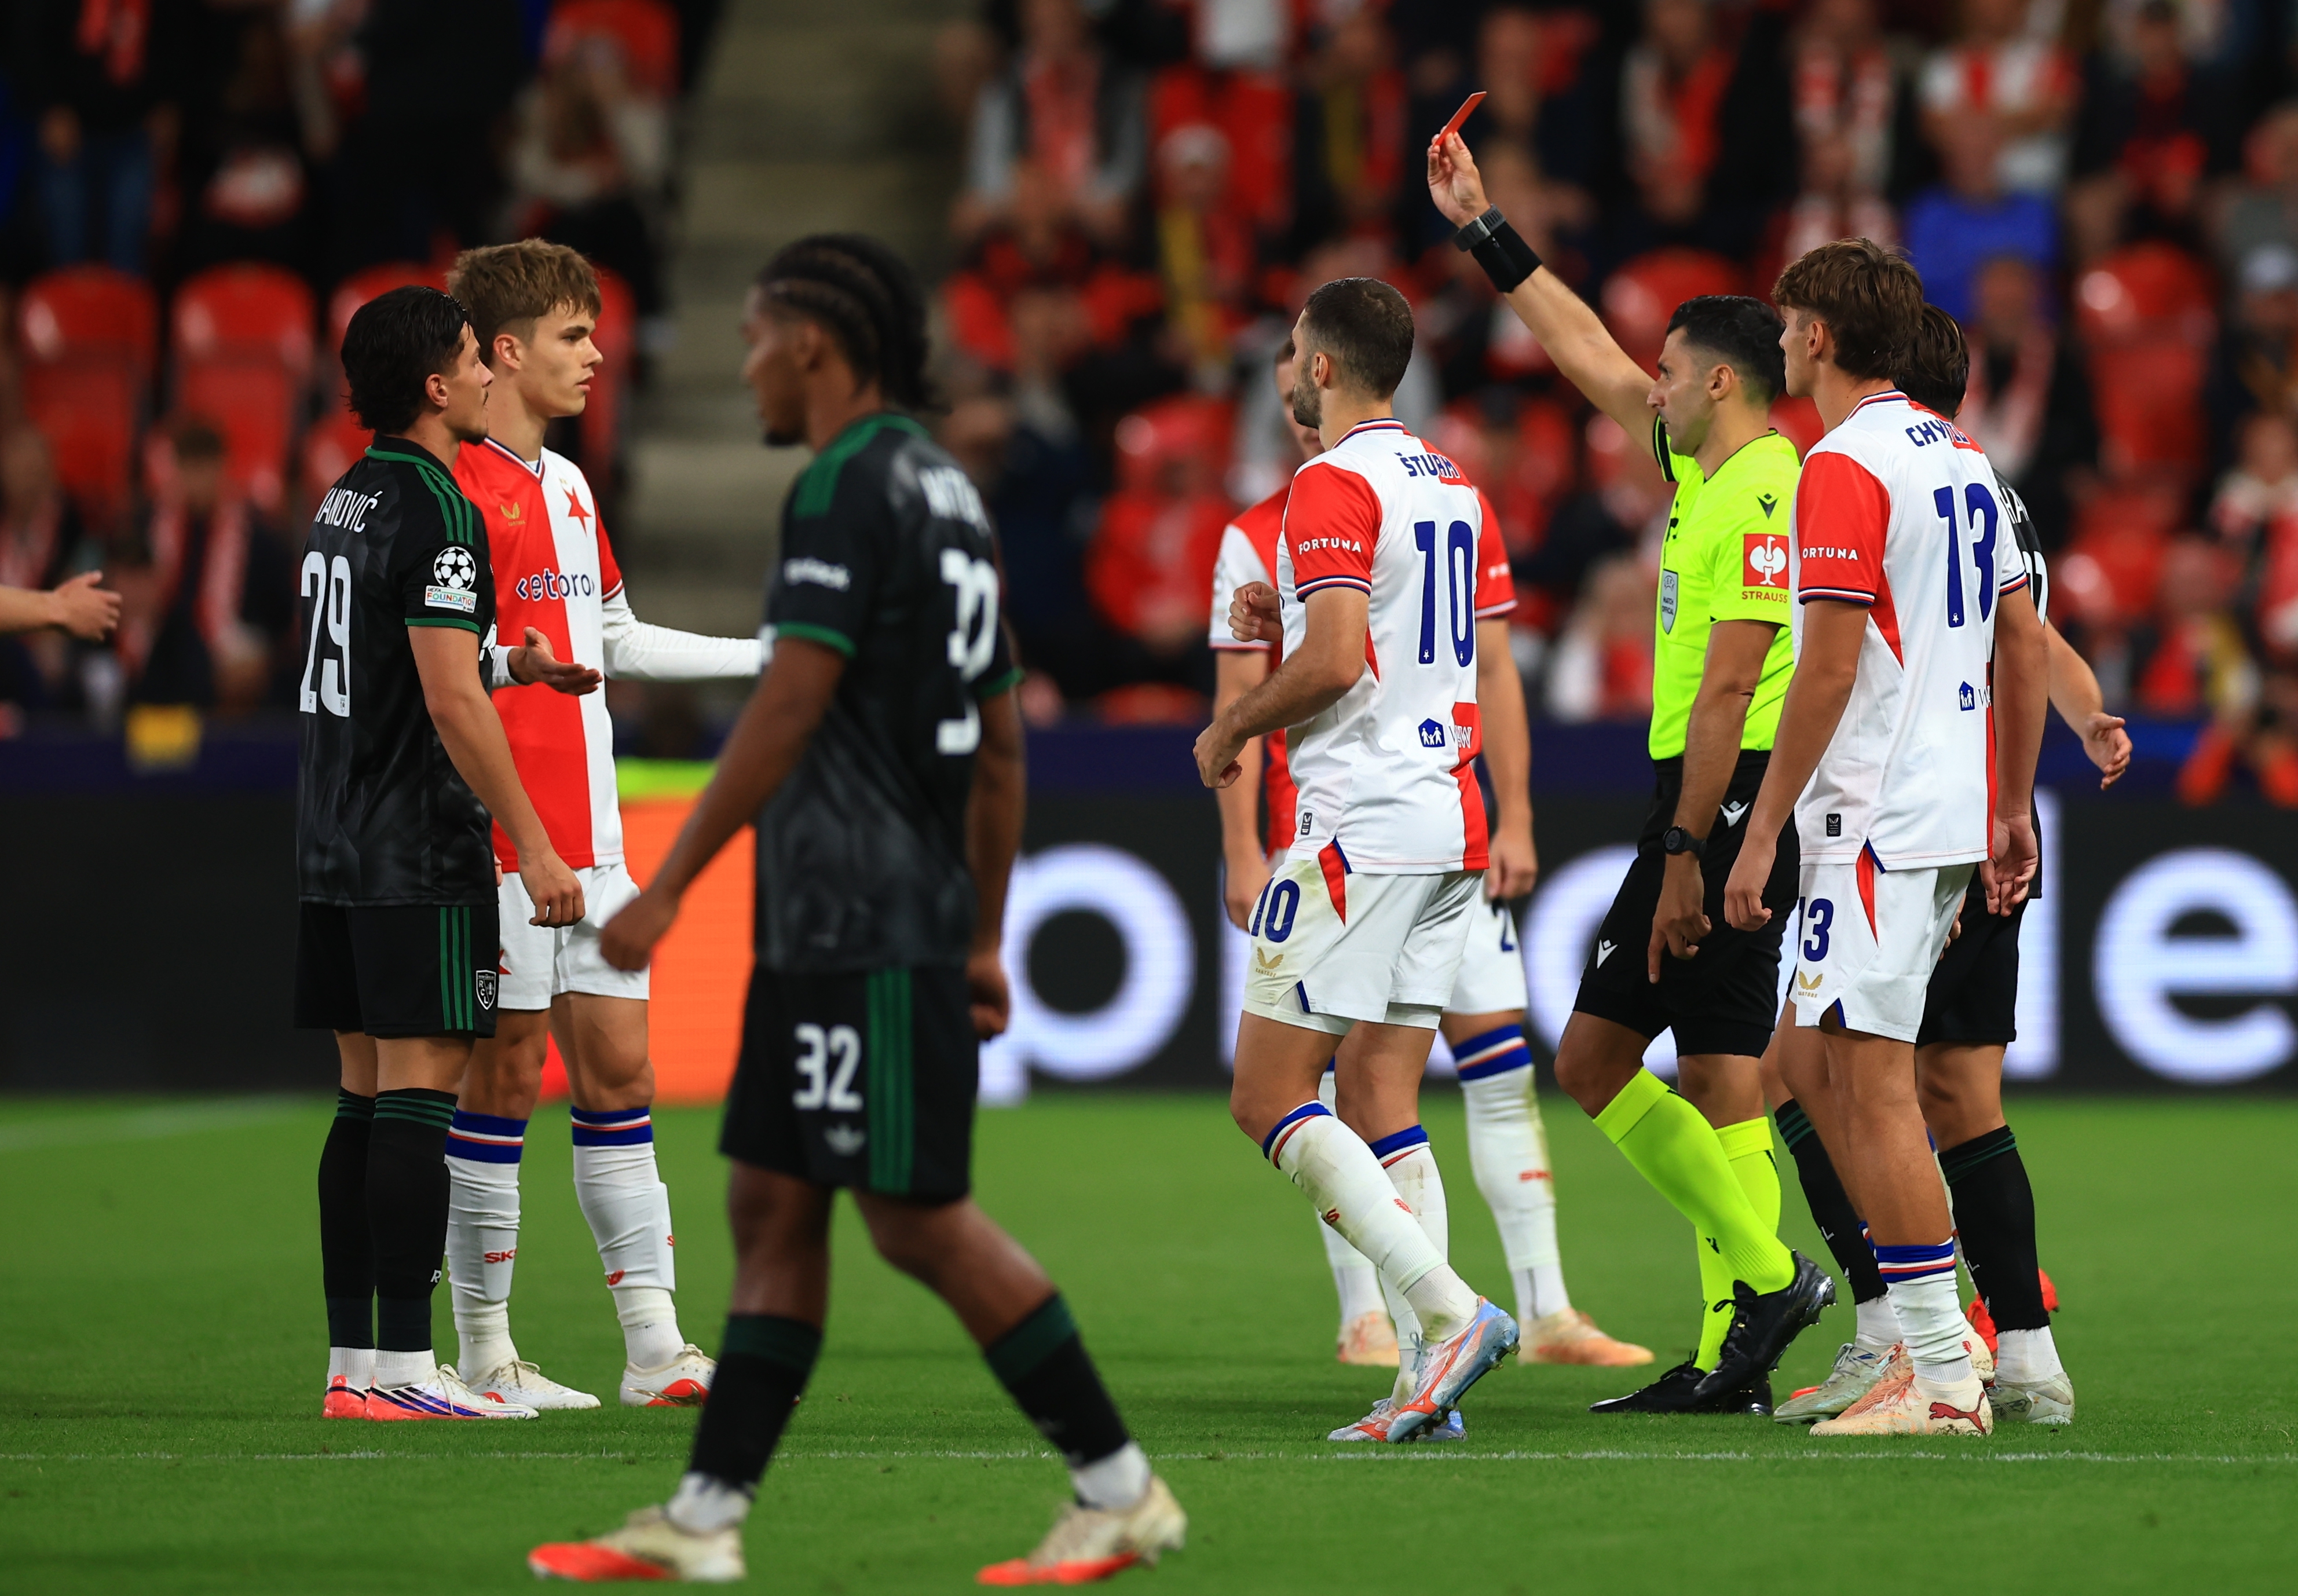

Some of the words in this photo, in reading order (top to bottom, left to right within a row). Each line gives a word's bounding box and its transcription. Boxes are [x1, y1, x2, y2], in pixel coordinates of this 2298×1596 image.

[1298, 537, 1362, 556] FORTUNA
[1933, 482, 1999, 628] 13
[426, 592, 475, 607] FOUNDATION
[1414, 520, 1474, 668] 10
[1741, 591, 1788, 603] STRAUSS
[299, 550, 352, 718] 29
[1251, 877, 1300, 943] 10
[792, 1022, 865, 1112] 32
[484, 1249, 518, 1264] SK
